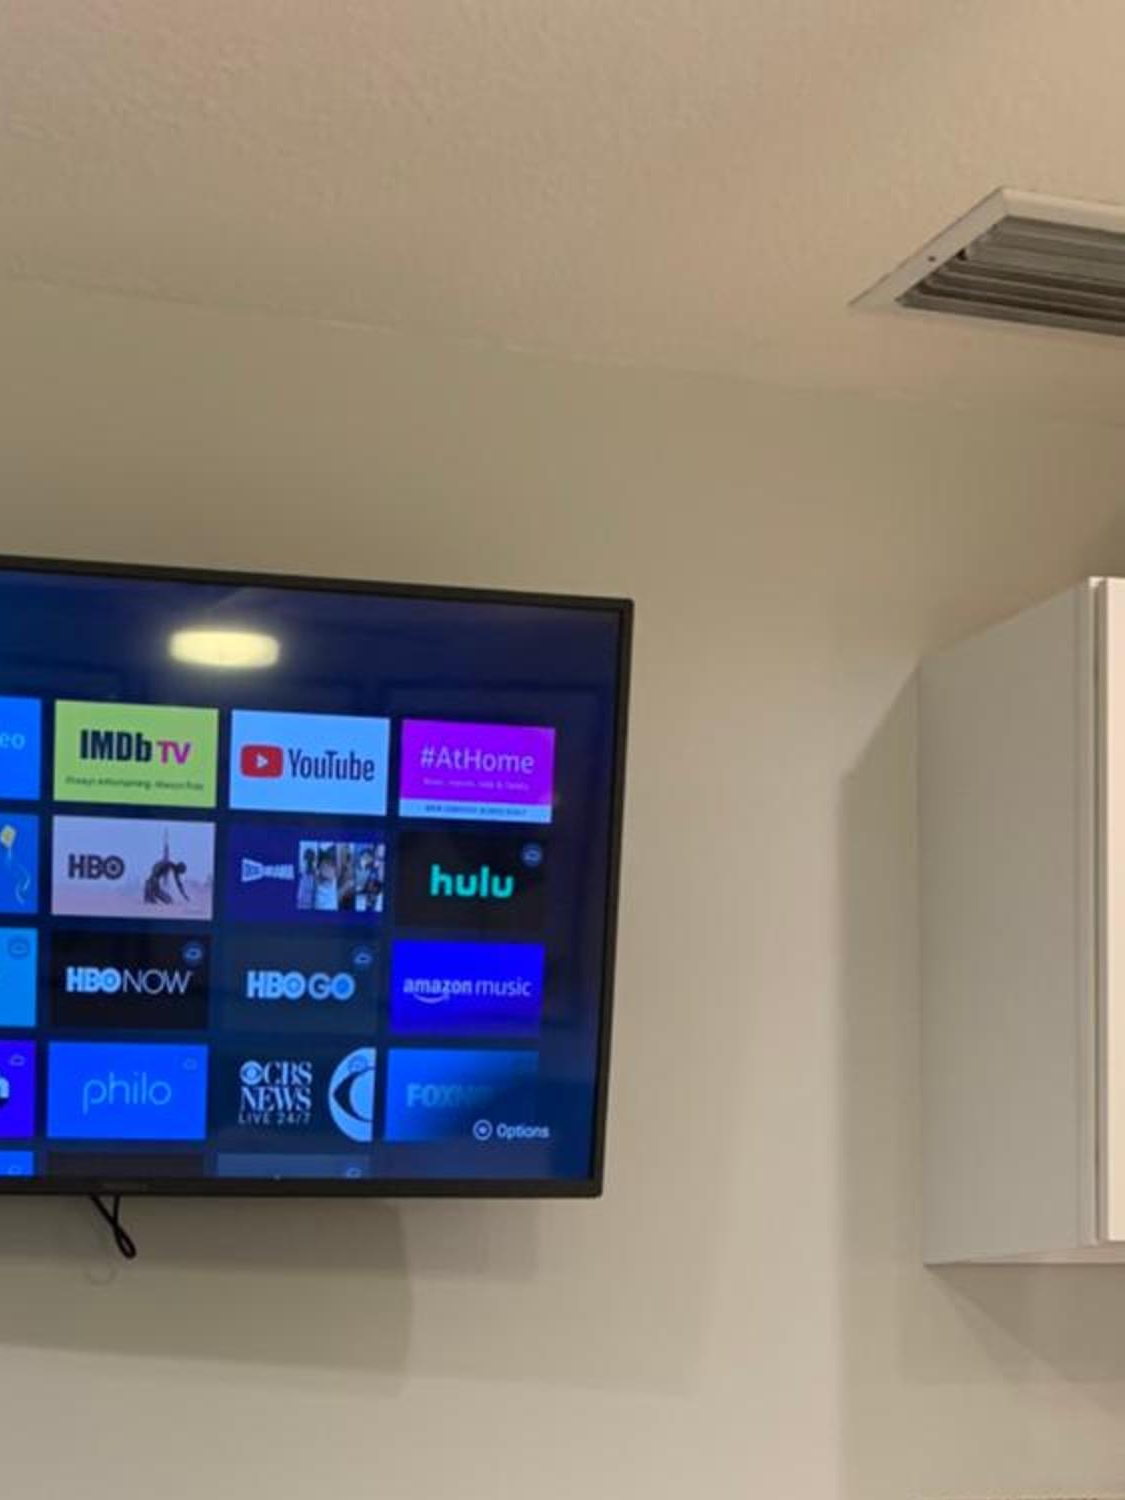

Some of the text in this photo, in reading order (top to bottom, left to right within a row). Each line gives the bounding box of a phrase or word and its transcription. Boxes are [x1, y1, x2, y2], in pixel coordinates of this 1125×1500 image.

[80, 729, 193, 765] IMDb TV
[420, 745, 535, 775] #AtHome
[288, 749, 375, 782] YouTube
[68, 853, 126, 881] HBO
[430, 864, 514, 899] hulu
[246, 970, 356, 1000] HBO GO
[403, 977, 532, 997] amazon music
[263, 1061, 313, 1086] CBS
[82, 1071, 172, 1114] philo
[241, 1086, 312, 1111] NEWS
[238, 1111, 271, 1125] LIVE
[496, 1122, 550, 1140] Options
